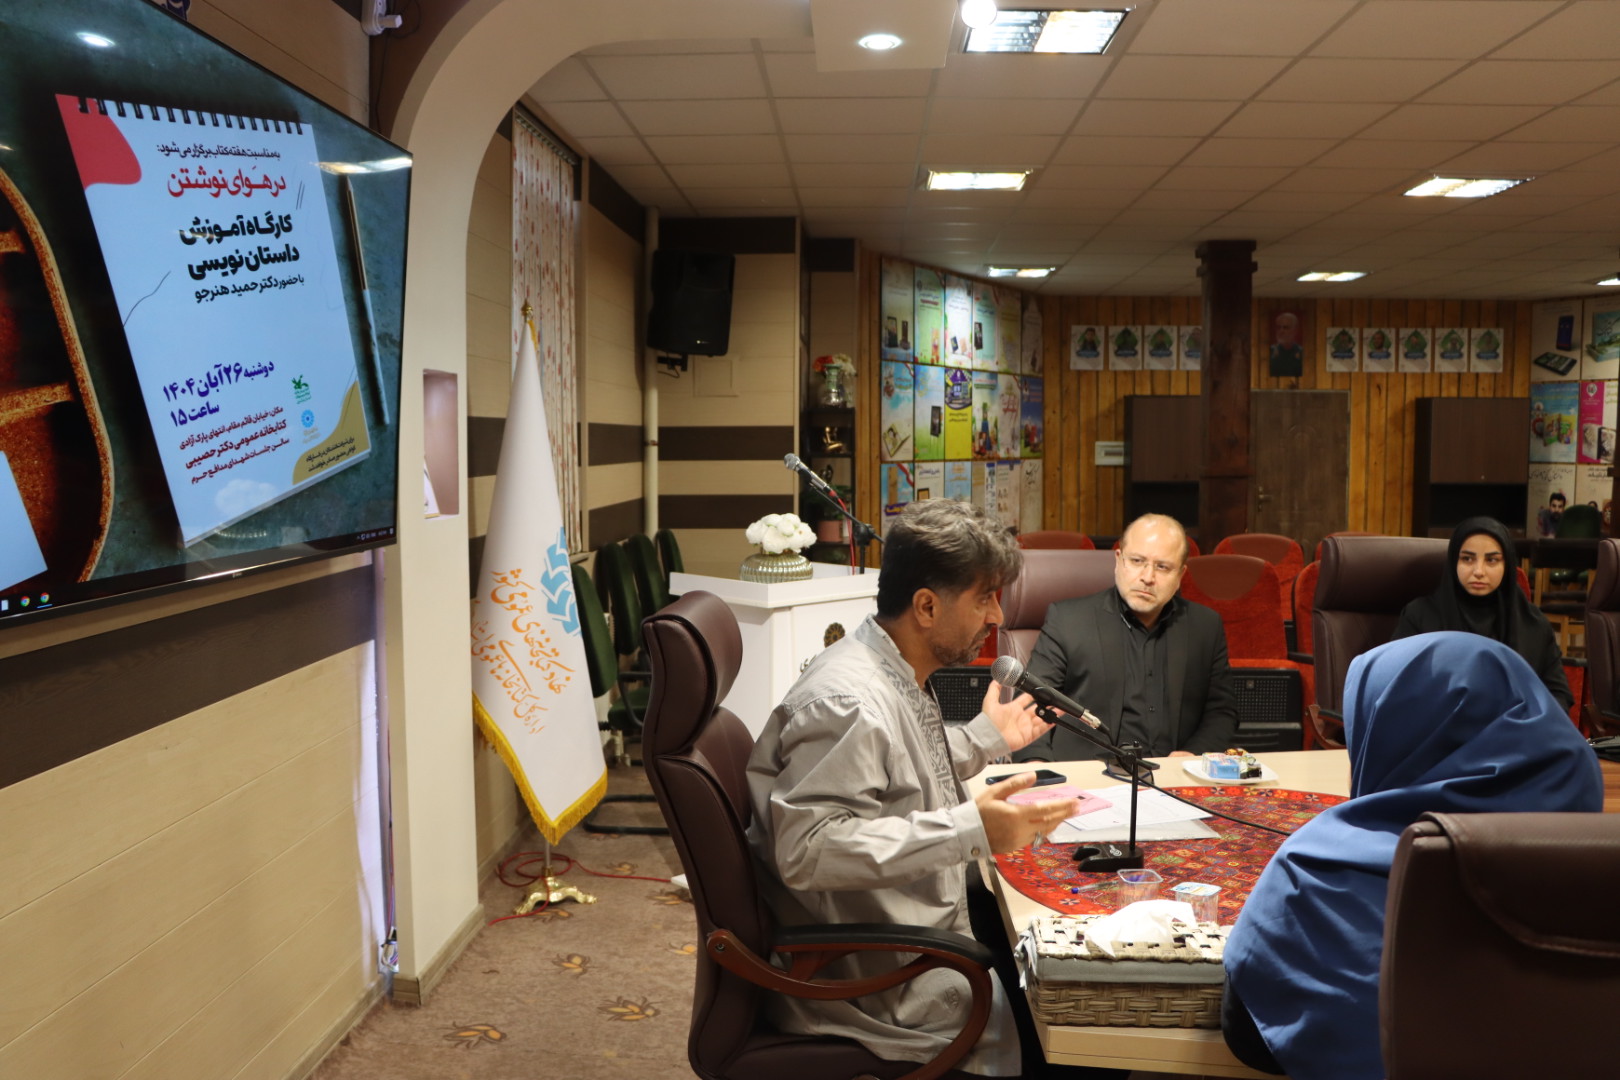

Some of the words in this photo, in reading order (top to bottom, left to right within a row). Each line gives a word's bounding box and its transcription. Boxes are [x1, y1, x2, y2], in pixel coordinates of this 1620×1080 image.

[167, 165, 229, 198] نوشتن
[270, 175, 286, 198] در
[179, 214, 247, 246] آموزش
[246, 210, 293, 240] کارگاه
[231, 280, 259, 298] حمید
[258, 275, 279, 294] دکتر
[278, 275, 299, 290] حضور
[194, 285, 230, 304] هنرجو
[197, 363, 224, 398] آبان
[222, 362, 243, 385] ۲۶
[243, 360, 275, 381] دوشنبه
[162, 377, 196, 403] ۱۴۰۴
[170, 408, 188, 428] ۱۵
[188, 400, 220, 422] ساعت
[259, 418, 287, 438] کتابخانه
[179, 434, 196, 450] آزادی
[217, 440, 234, 458] دکتر
[234, 431, 260, 450] عمومی
[490, 568, 536, 592] کشور
[490, 586, 533, 614] عمومی
[542, 671, 572, 694] نهاد
